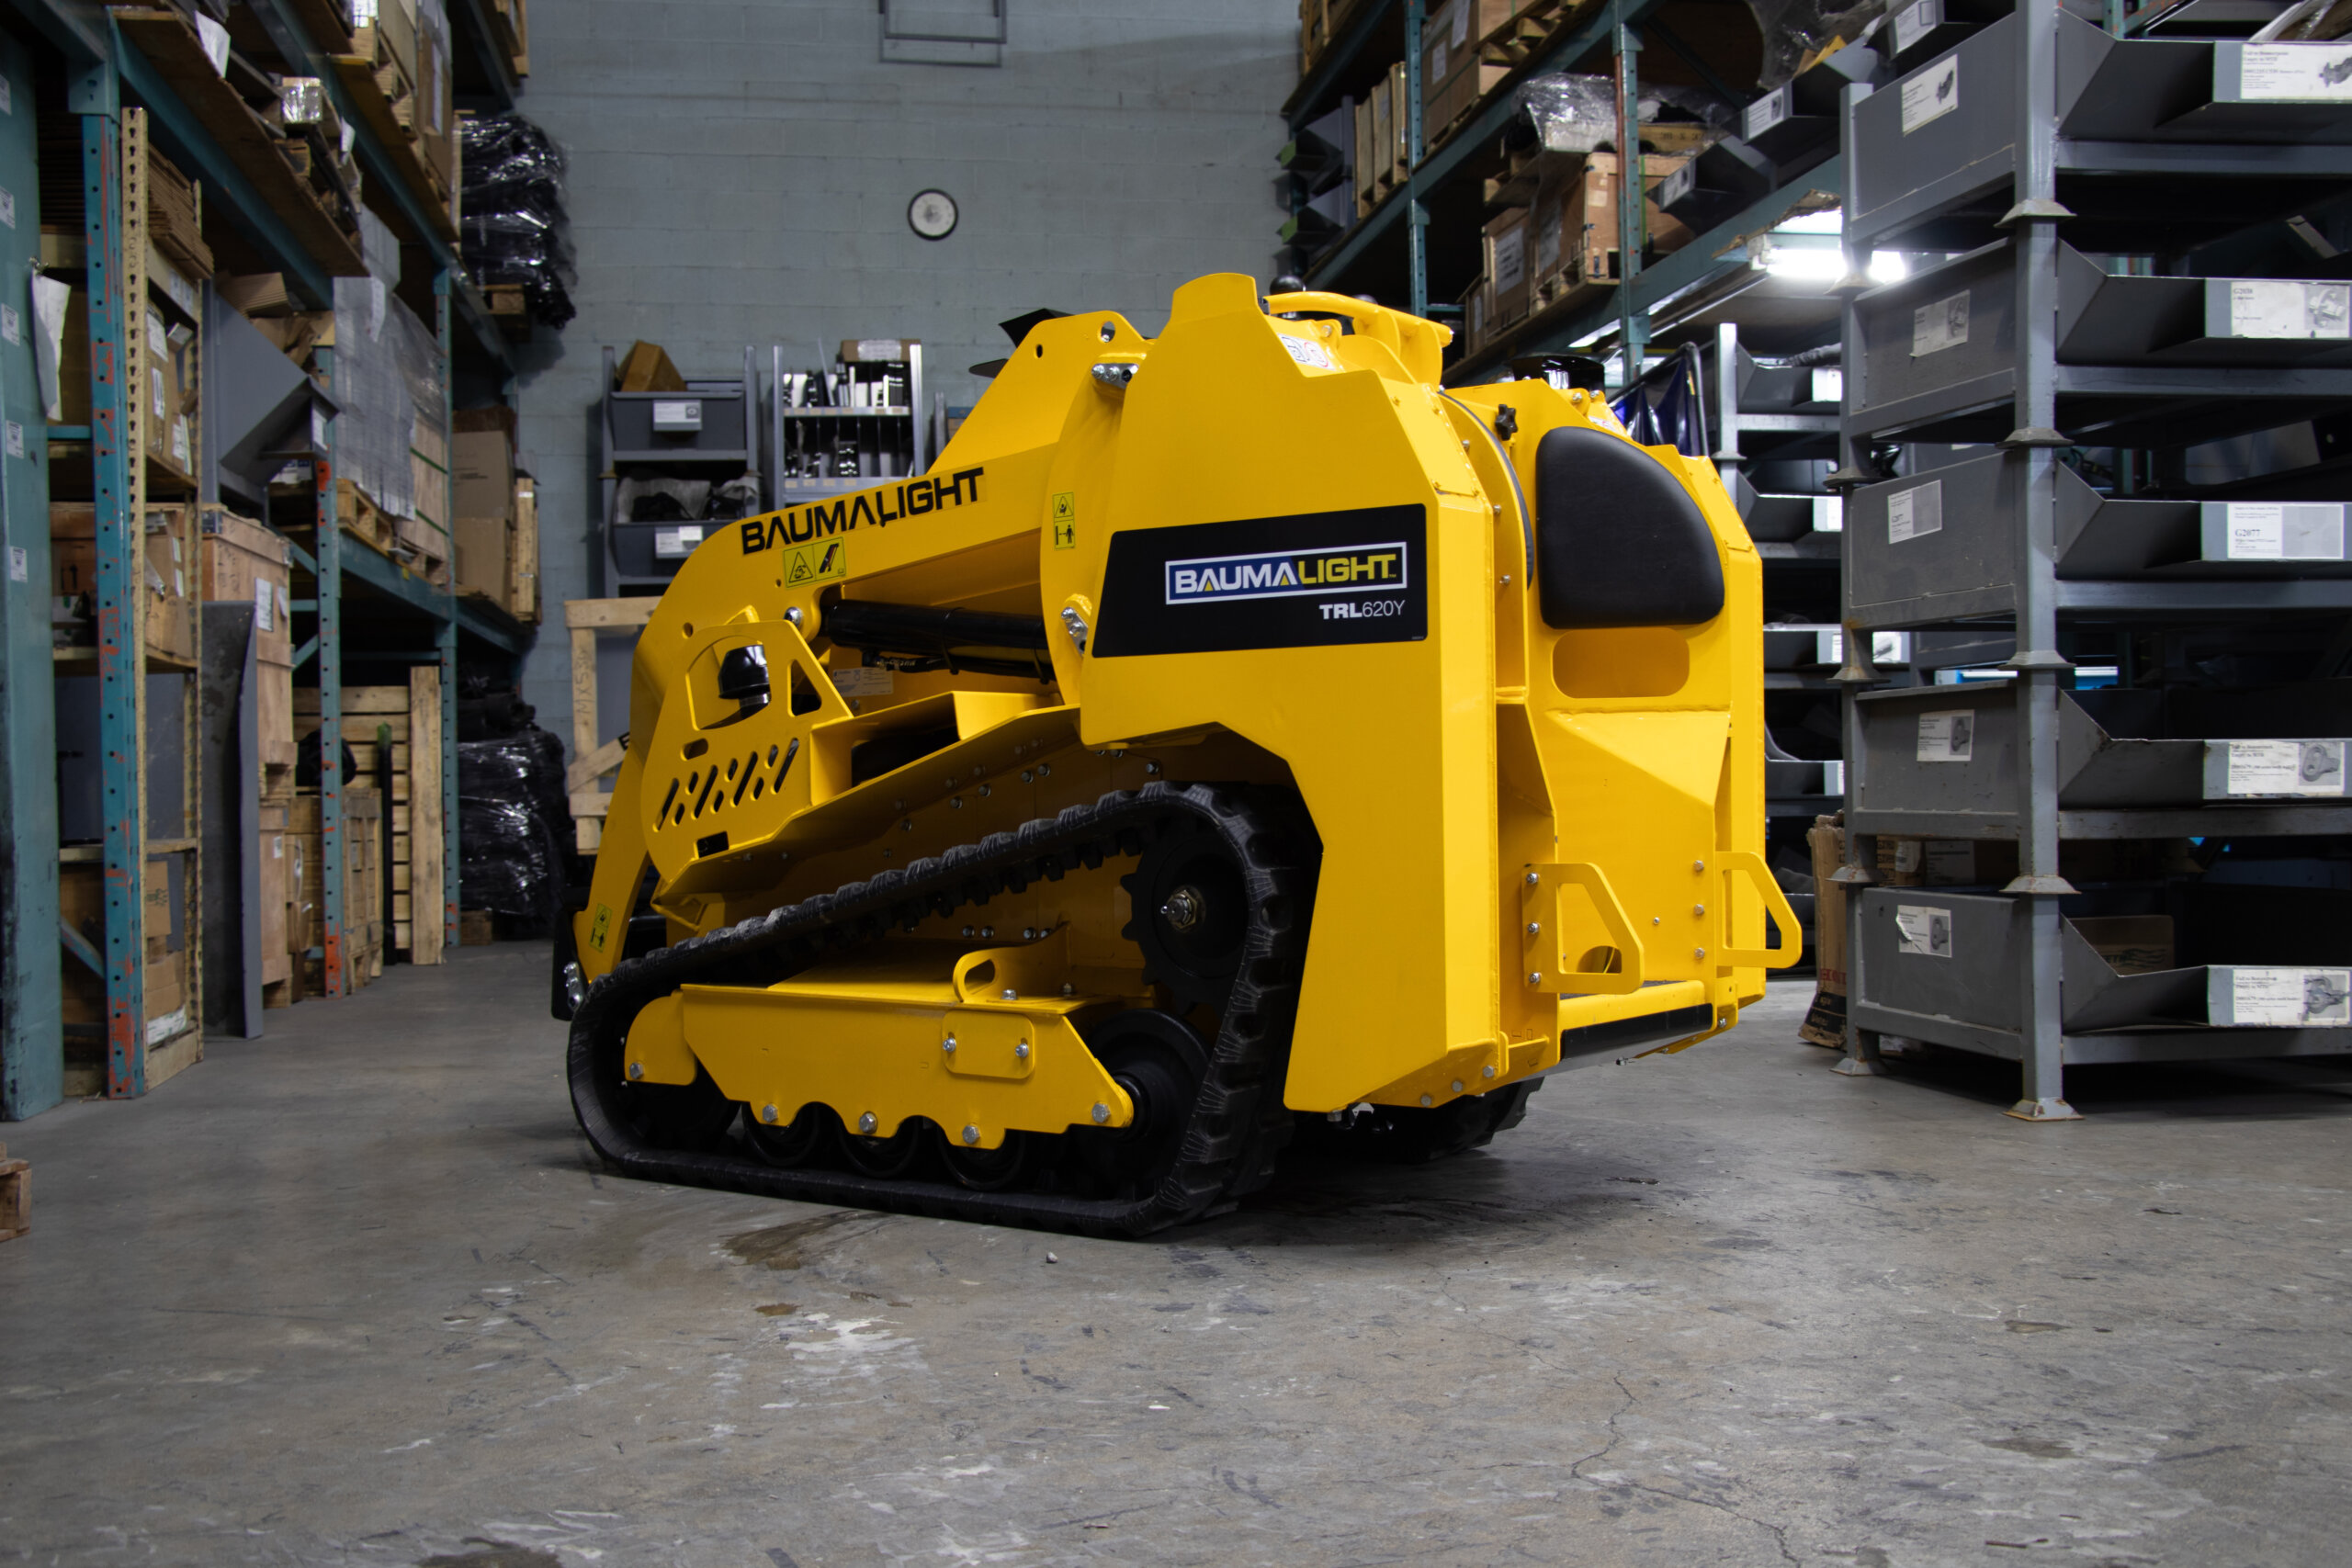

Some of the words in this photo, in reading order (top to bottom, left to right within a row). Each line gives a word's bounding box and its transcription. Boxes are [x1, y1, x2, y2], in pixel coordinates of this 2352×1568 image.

[741, 467, 984, 555] BAUMALIGHT
[1175, 554, 1396, 593] BAUMALIGHT
[1318, 600, 1406, 620] TRL620Y
